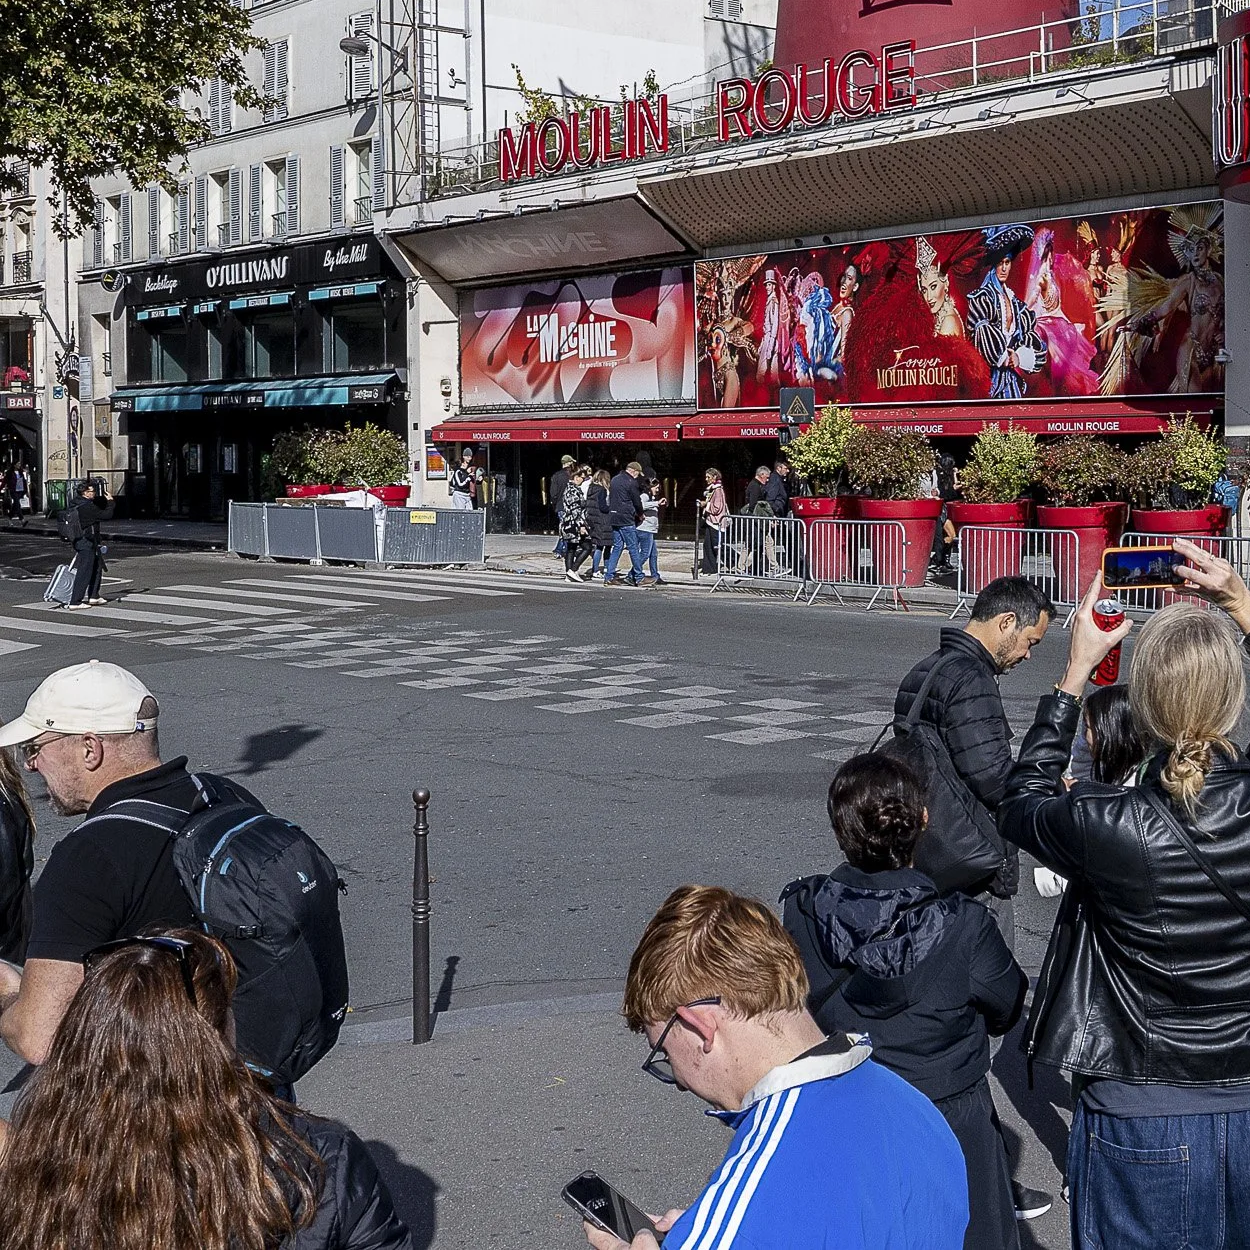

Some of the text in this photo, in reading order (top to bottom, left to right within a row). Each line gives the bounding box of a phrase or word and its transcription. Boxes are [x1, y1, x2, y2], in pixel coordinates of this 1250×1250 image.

[500, 40, 917, 181] MOULIN ROUGE
[323, 243, 368, 271] By the Mill
[206, 256, 289, 288] O'SULLIVANS
[144, 275, 178, 293] Backstage
[526, 315, 540, 333] LA
[888, 345, 942, 371] Forever
[876, 364, 959, 390] MOULIN ROUGE
[9, 398, 31, 407] BAR
[604, 431, 625, 439] ROUGE
[914, 425, 943, 434] ROUGE
[1047, 421, 1120, 431] MOULIN ROUGE
